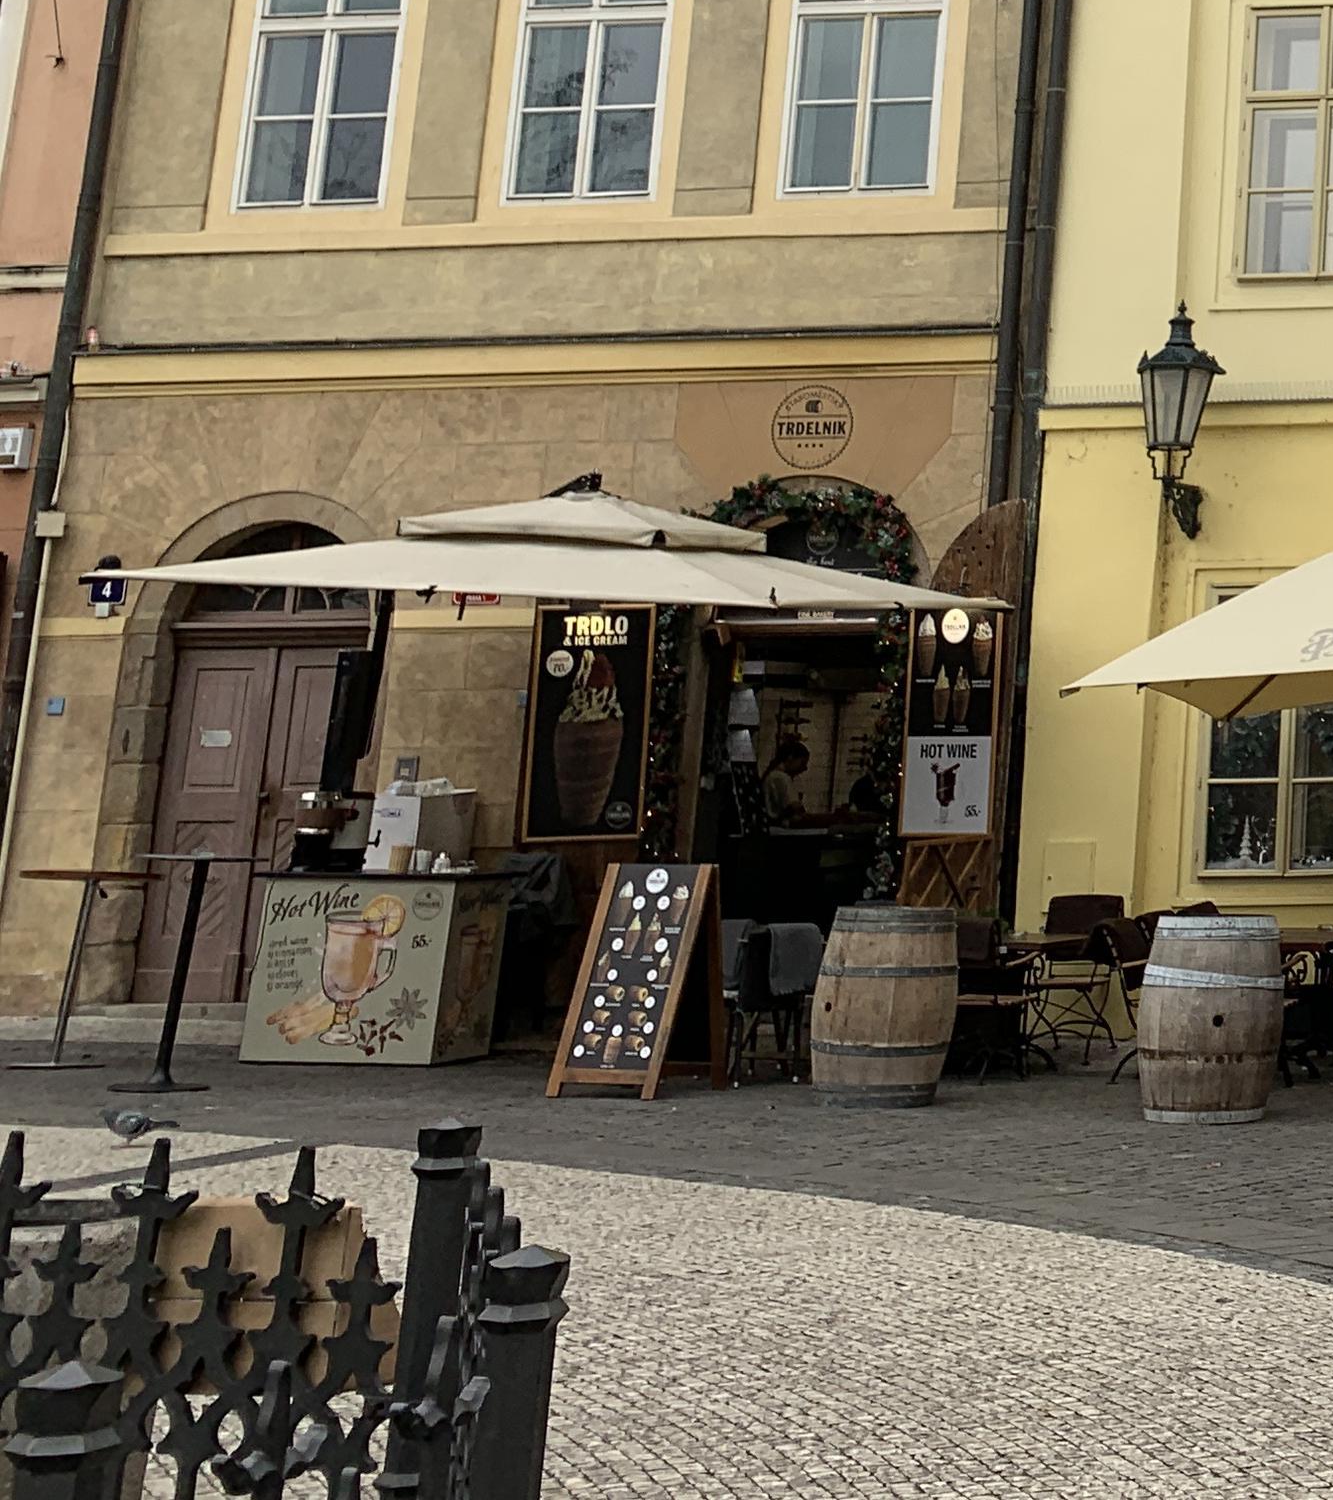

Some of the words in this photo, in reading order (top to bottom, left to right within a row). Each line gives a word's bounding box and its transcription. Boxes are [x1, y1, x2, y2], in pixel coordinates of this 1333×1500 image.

[777, 420, 846, 436] TRDELNIK
[101, 581, 112, 598] 4
[564, 615, 629, 636] TRDLO
[563, 636, 572, 646] &
[574, 636, 591, 646] ICE
[593, 635, 628, 646] CREAM
[920, 744, 944, 758] HOT
[946, 743, 978, 758] WINE
[269, 896, 305, 925] Hot
[305, 883, 360, 917] Wine
